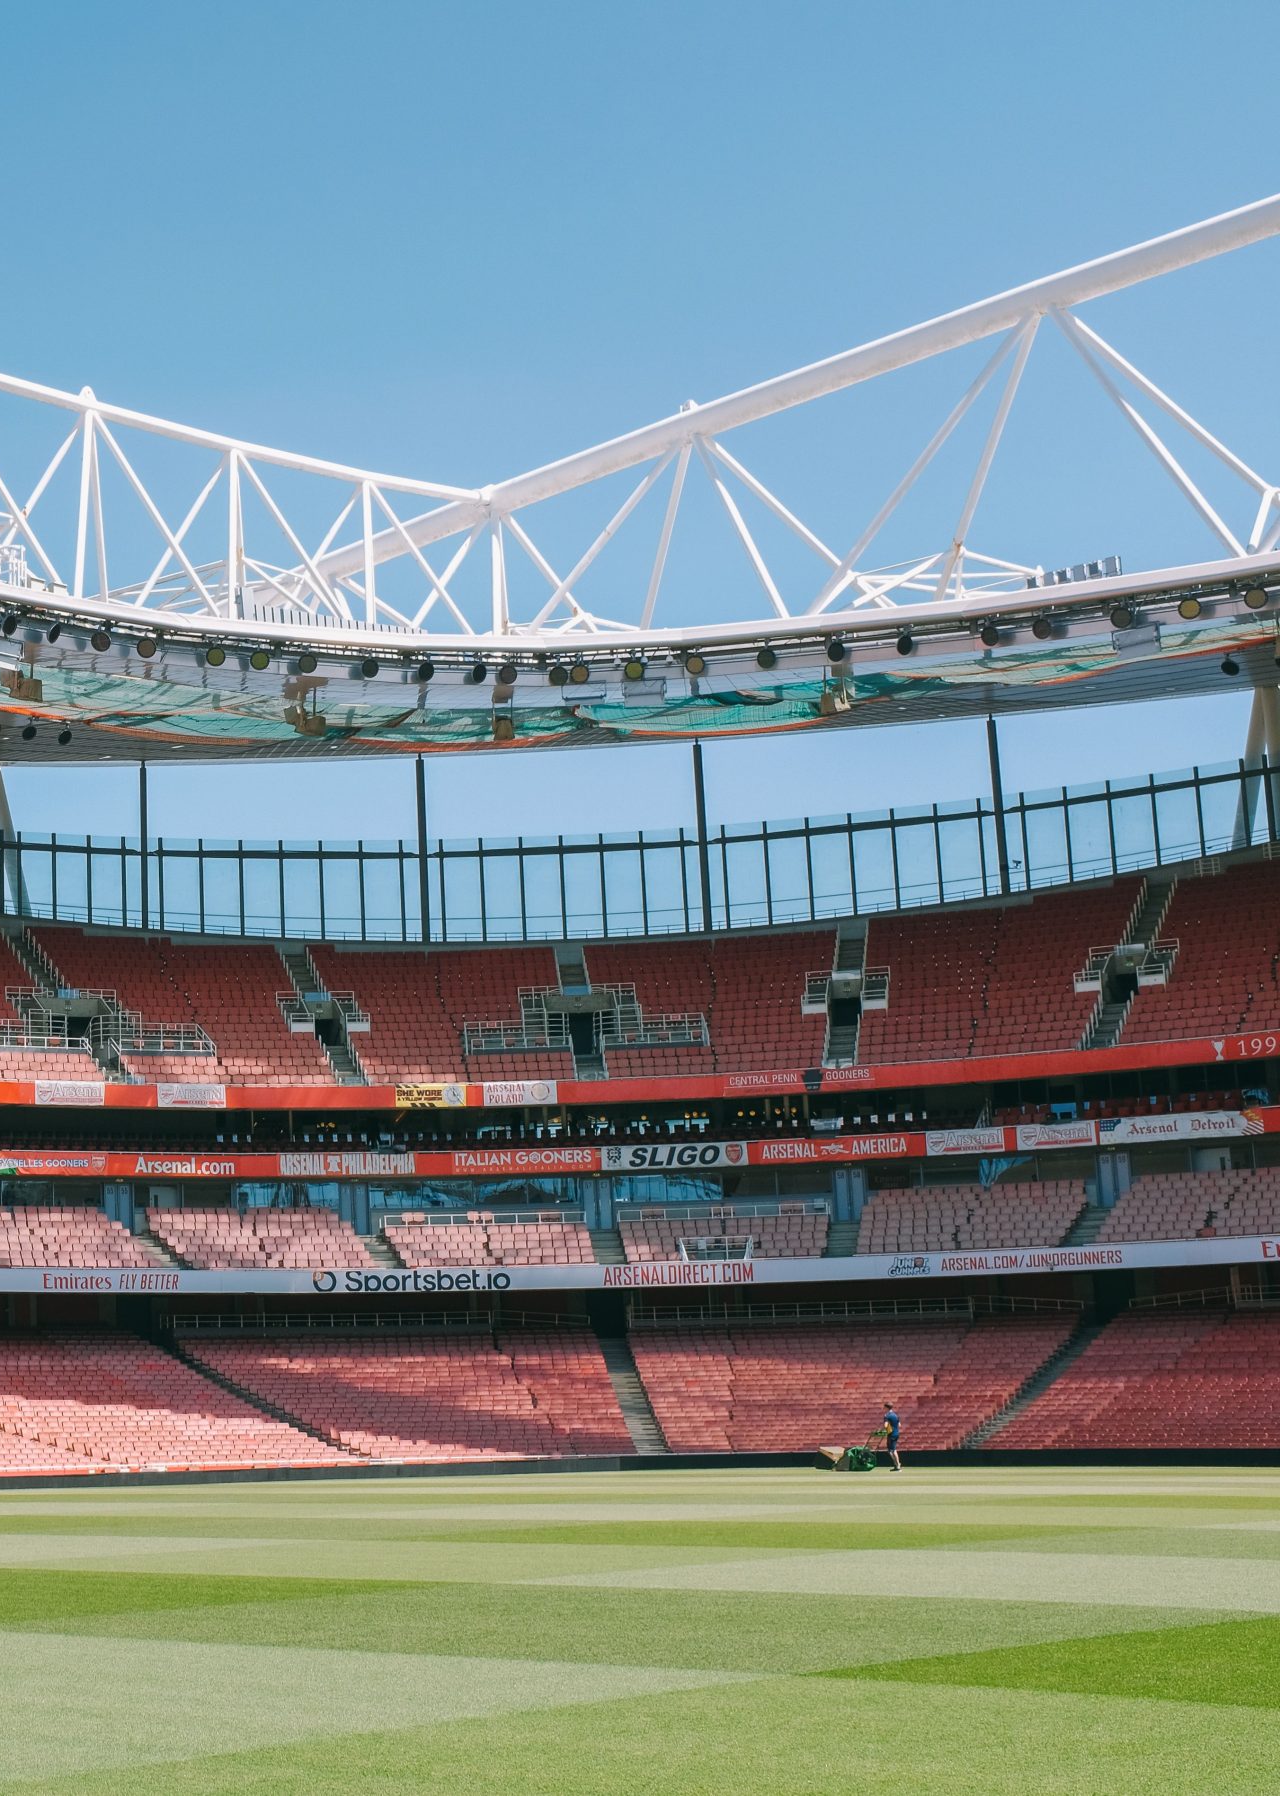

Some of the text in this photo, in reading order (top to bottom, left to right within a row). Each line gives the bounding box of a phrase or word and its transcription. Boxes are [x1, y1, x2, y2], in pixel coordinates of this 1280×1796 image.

[1237, 1036, 1276, 1056] 199
[729, 1069, 870, 1086] CENTRAL PENN GOONERS
[53, 1081, 103, 1097] Arsenal
[175, 1084, 225, 1100] Arsenal
[397, 1089, 442, 1097] SHE WORE
[487, 1083, 525, 1094] ARSENAL
[489, 1093, 524, 1104] POLAND
[1037, 1124, 1092, 1142] Arsenal
[1127, 1118, 1236, 1137] Arsenal Detroit
[946, 1128, 1002, 1147] Arsenal
[628, 1145, 720, 1167] SLIGO
[762, 1137, 907, 1159] ARSENAL AMERICA
[46, 1158, 89, 1168] GOONERS
[135, 1156, 235, 1175] Arsenal.com
[280, 1153, 416, 1175] ARSENAL PHILADELPHIA
[454, 1150, 592, 1166] ITALIAN GOONERS
[941, 1249, 1123, 1272] ARSENAL.COM/JUNIORGUNNERS
[43, 1273, 179, 1290] Emirates FLY BETTER
[344, 1270, 511, 1292] Sportsbet.io
[603, 1262, 755, 1287] ARSENALDIRECT.COM
